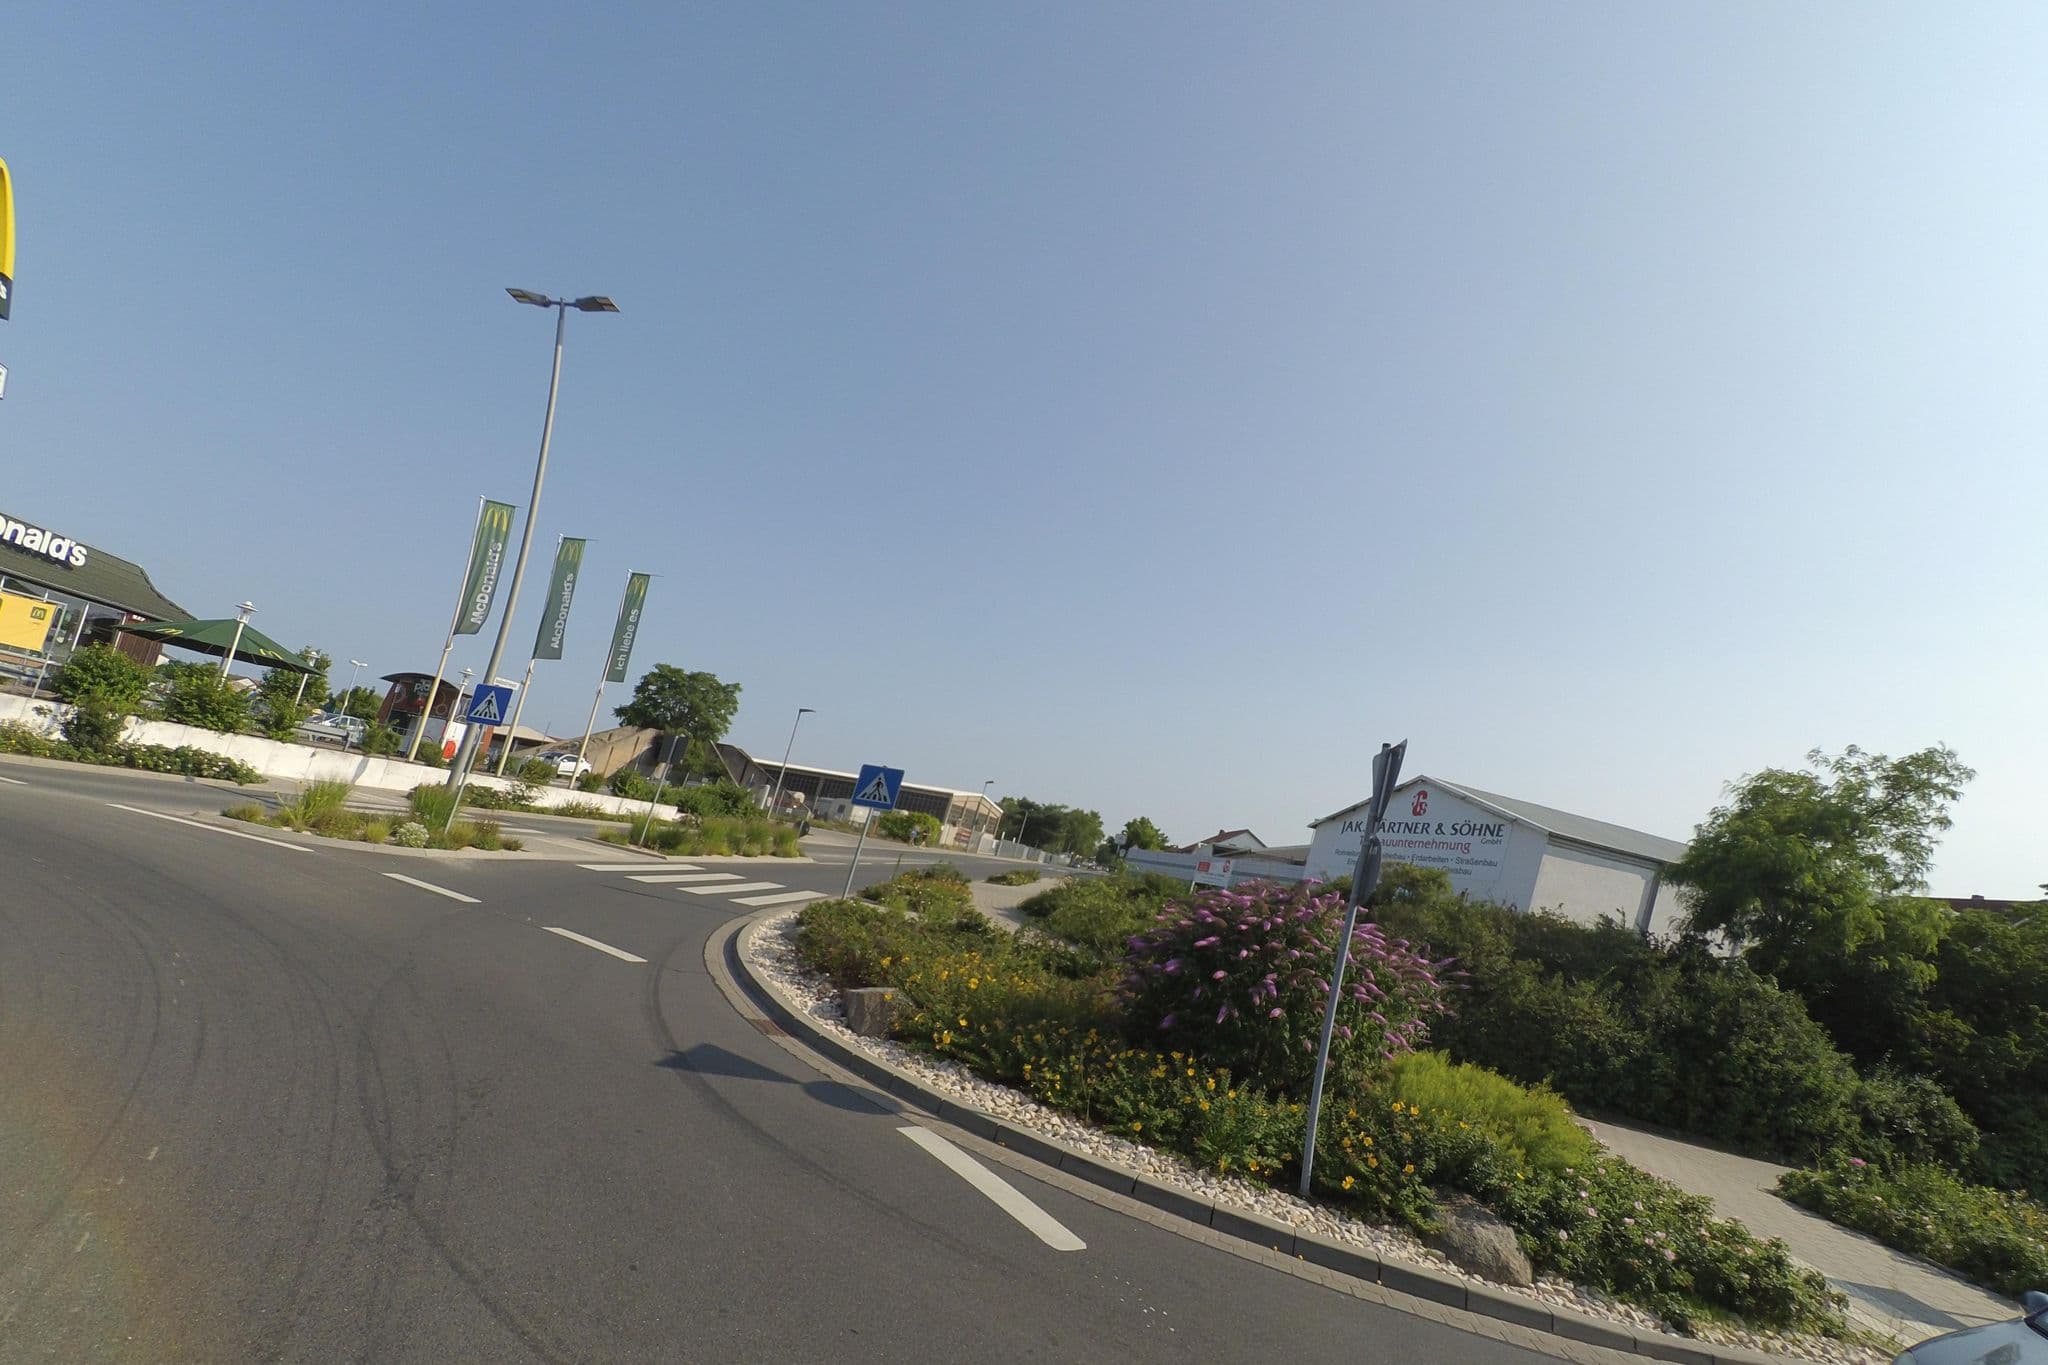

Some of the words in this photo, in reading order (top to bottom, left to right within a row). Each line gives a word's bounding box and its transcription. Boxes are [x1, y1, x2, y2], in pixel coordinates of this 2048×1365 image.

[1378, 818, 1431, 835] ÄRTNER
[1434, 822, 1446, 836] &
[1450, 819, 1506, 838] SÖHNE
[1480, 837, 1503, 846] GmbH
